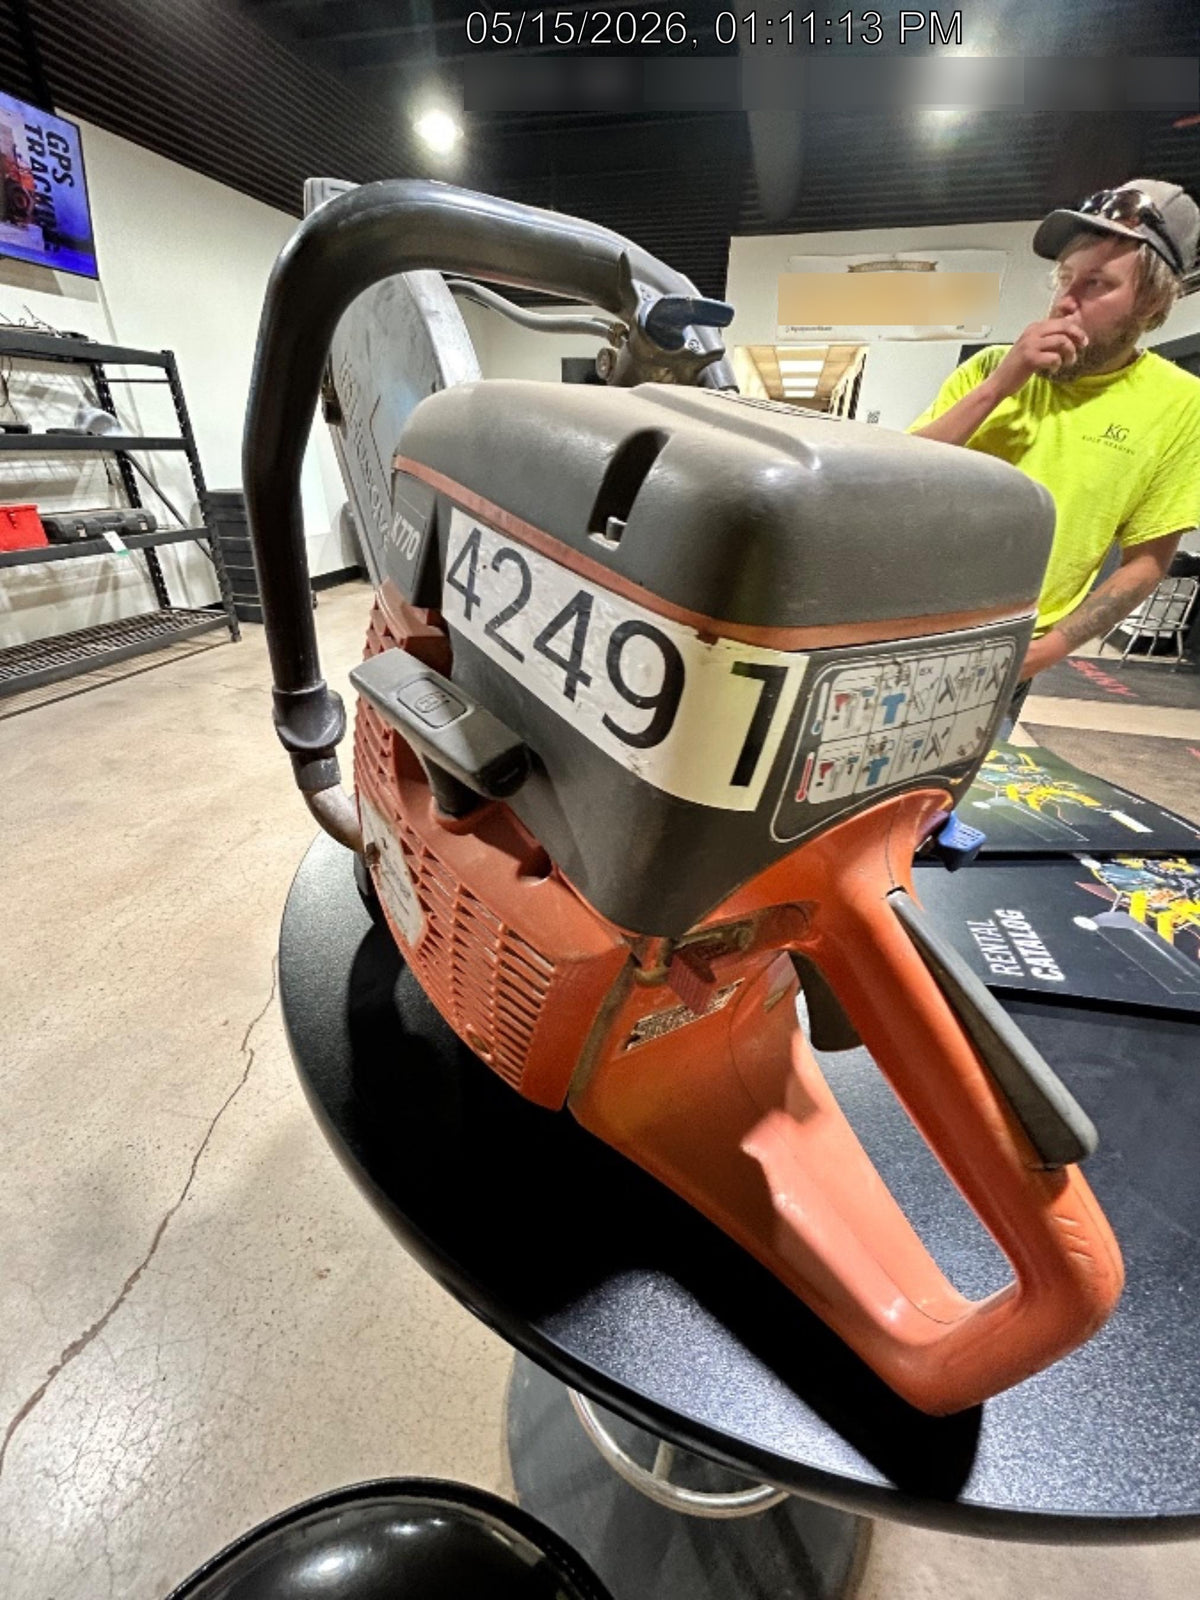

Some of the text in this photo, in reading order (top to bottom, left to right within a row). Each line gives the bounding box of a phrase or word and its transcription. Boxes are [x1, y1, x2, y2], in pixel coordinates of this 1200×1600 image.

[46, 130, 75, 188] GPS
[1099, 422, 1130, 443] KG
[966, 918, 1025, 977] RENTAL
[994, 908, 1066, 981] CATALOG
